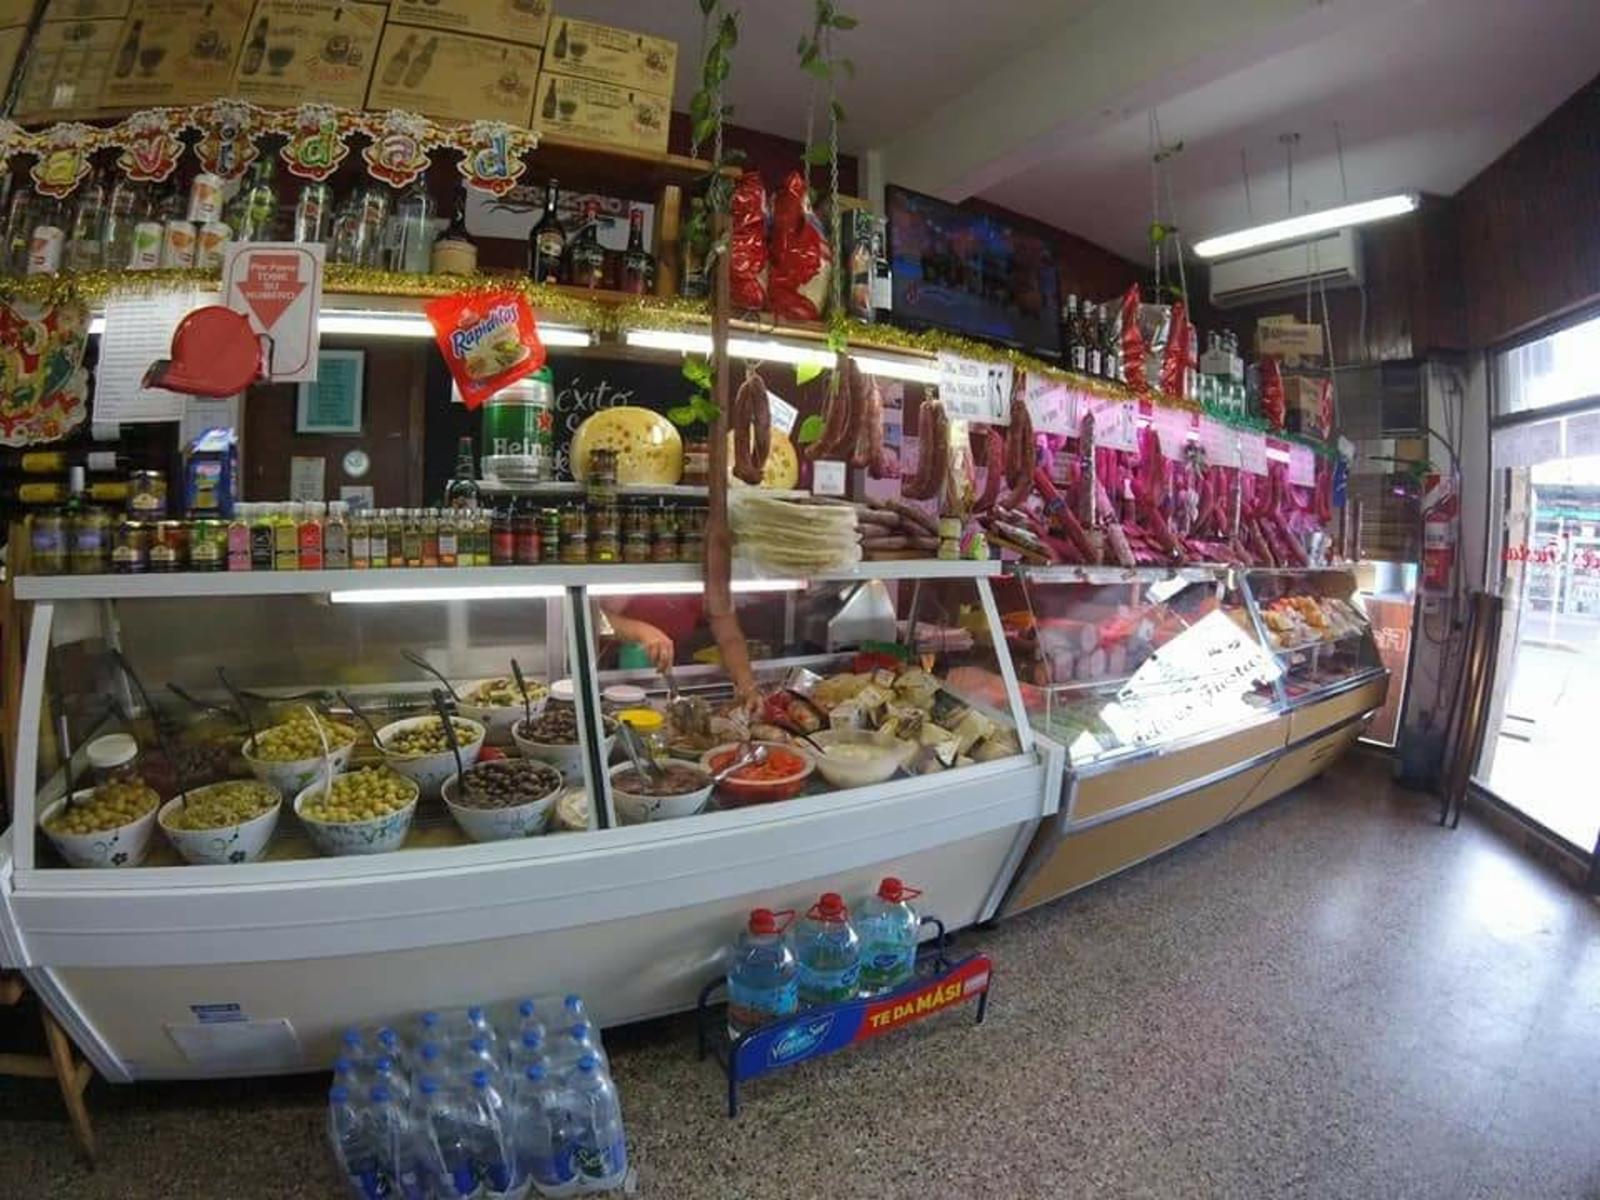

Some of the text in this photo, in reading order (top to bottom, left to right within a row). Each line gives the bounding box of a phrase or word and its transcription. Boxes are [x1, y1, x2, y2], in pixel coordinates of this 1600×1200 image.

[257, 273, 288, 281] TOME
[263, 282, 280, 291] SU
[449, 301, 520, 359] Rapiditas
[868, 1010, 891, 1028] TE
[893, 1003, 914, 1021] DA
